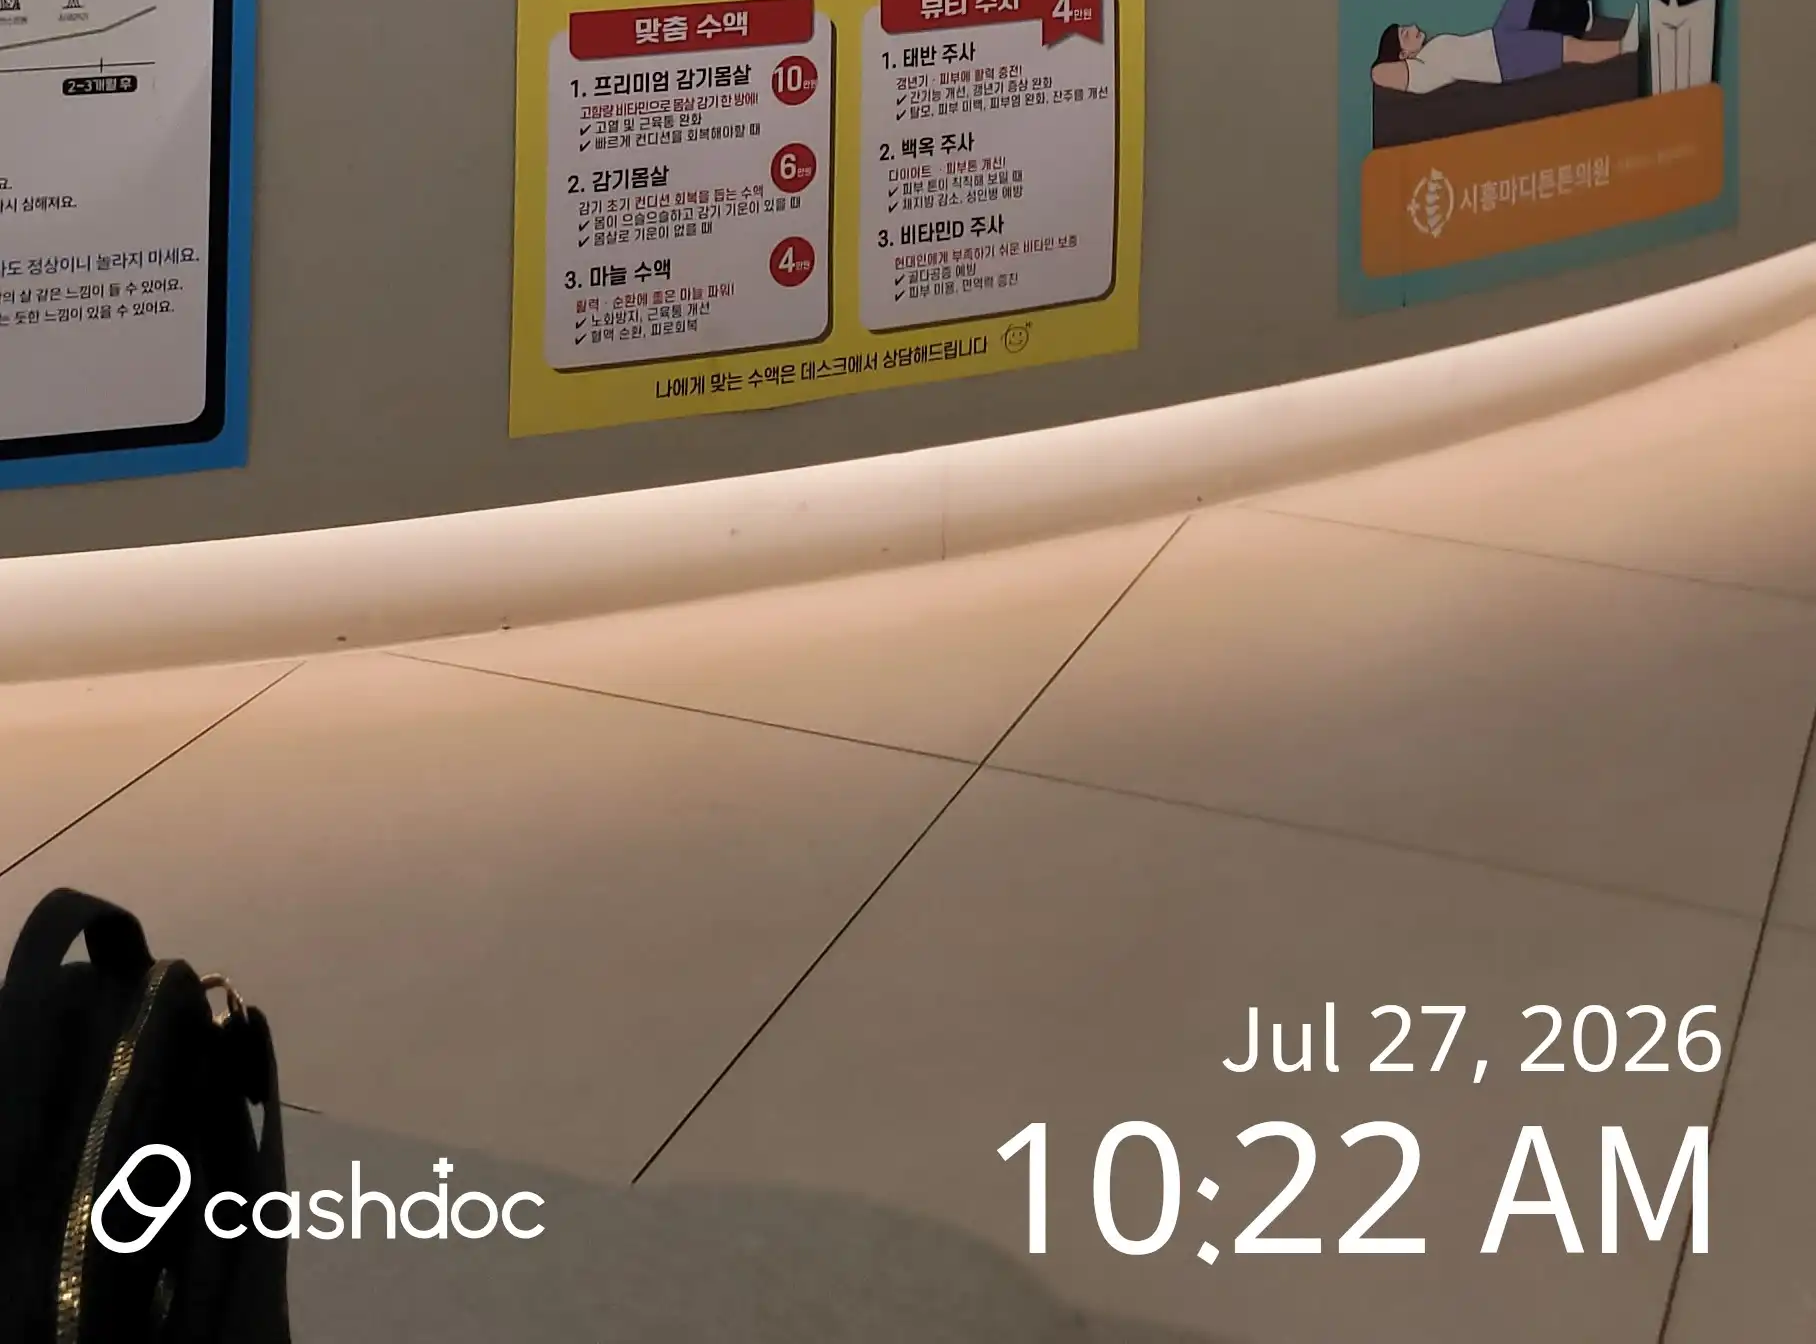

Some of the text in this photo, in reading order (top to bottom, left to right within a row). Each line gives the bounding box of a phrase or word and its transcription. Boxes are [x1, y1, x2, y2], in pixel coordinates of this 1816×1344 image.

[636, 11, 748, 45] 맞춤 수액
[883, 41, 976, 69] 1. 태반 주사
[570, 64, 752, 98] 1. 프리미엄 감기몸살
[596, 135, 630, 150] 빠르게
[636, 130, 682, 146] 컨디션을
[750, 123, 760, 136] 때
[880, 132, 975, 161] 2. 백옥 주사
[568, 166, 670, 194] 2. 감기몸살
[878, 213, 1004, 248] 3. 비타민D 주사
[27, 255, 91, 276] 정상이니
[96, 250, 143, 271] 놀라지
[148, 247, 200, 266] 마세요.
[564, 259, 671, 290] 3. 마늘 수액
[65, 283, 105, 301] 느낌이
[126, 281, 137, 295] 수
[141, 277, 183, 293] 있어요.
[45, 305, 83, 323] 느낌이
[116, 303, 128, 318] 수
[133, 301, 174, 316] 있어요.
[656, 336, 987, 398] 나에게 맞는 수액은 데스크에서 상담해드립니다
